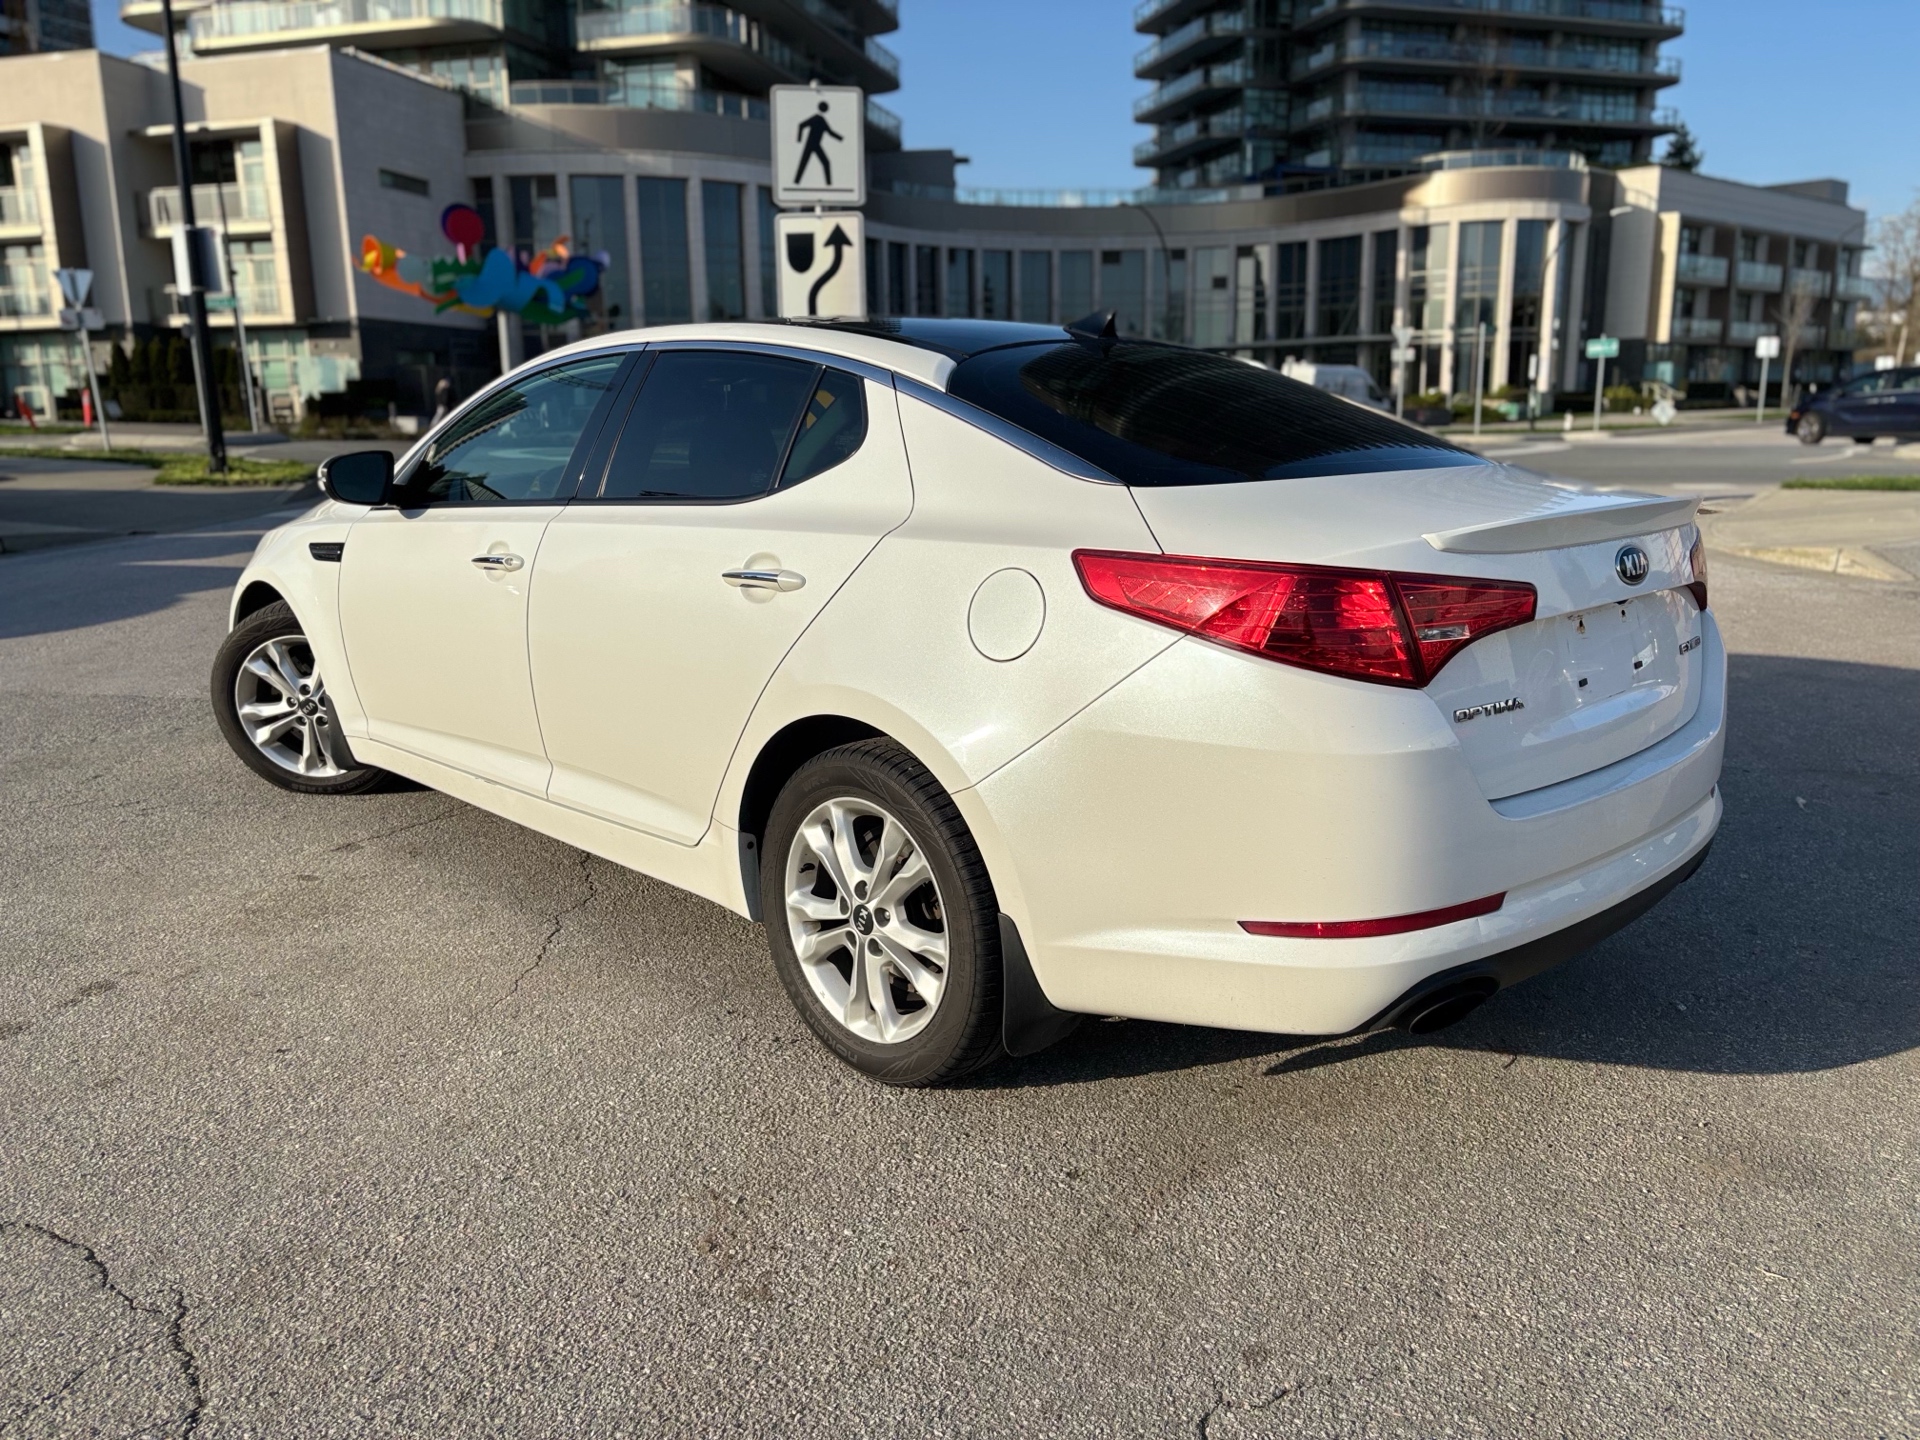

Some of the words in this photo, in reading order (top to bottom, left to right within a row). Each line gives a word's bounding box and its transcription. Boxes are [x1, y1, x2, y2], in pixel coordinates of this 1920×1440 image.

[1622, 552, 1648, 577] KIA
[302, 702, 316, 715] KIA
[1453, 697, 1525, 723] OPTIMA
[858, 908, 869, 931] KIA
